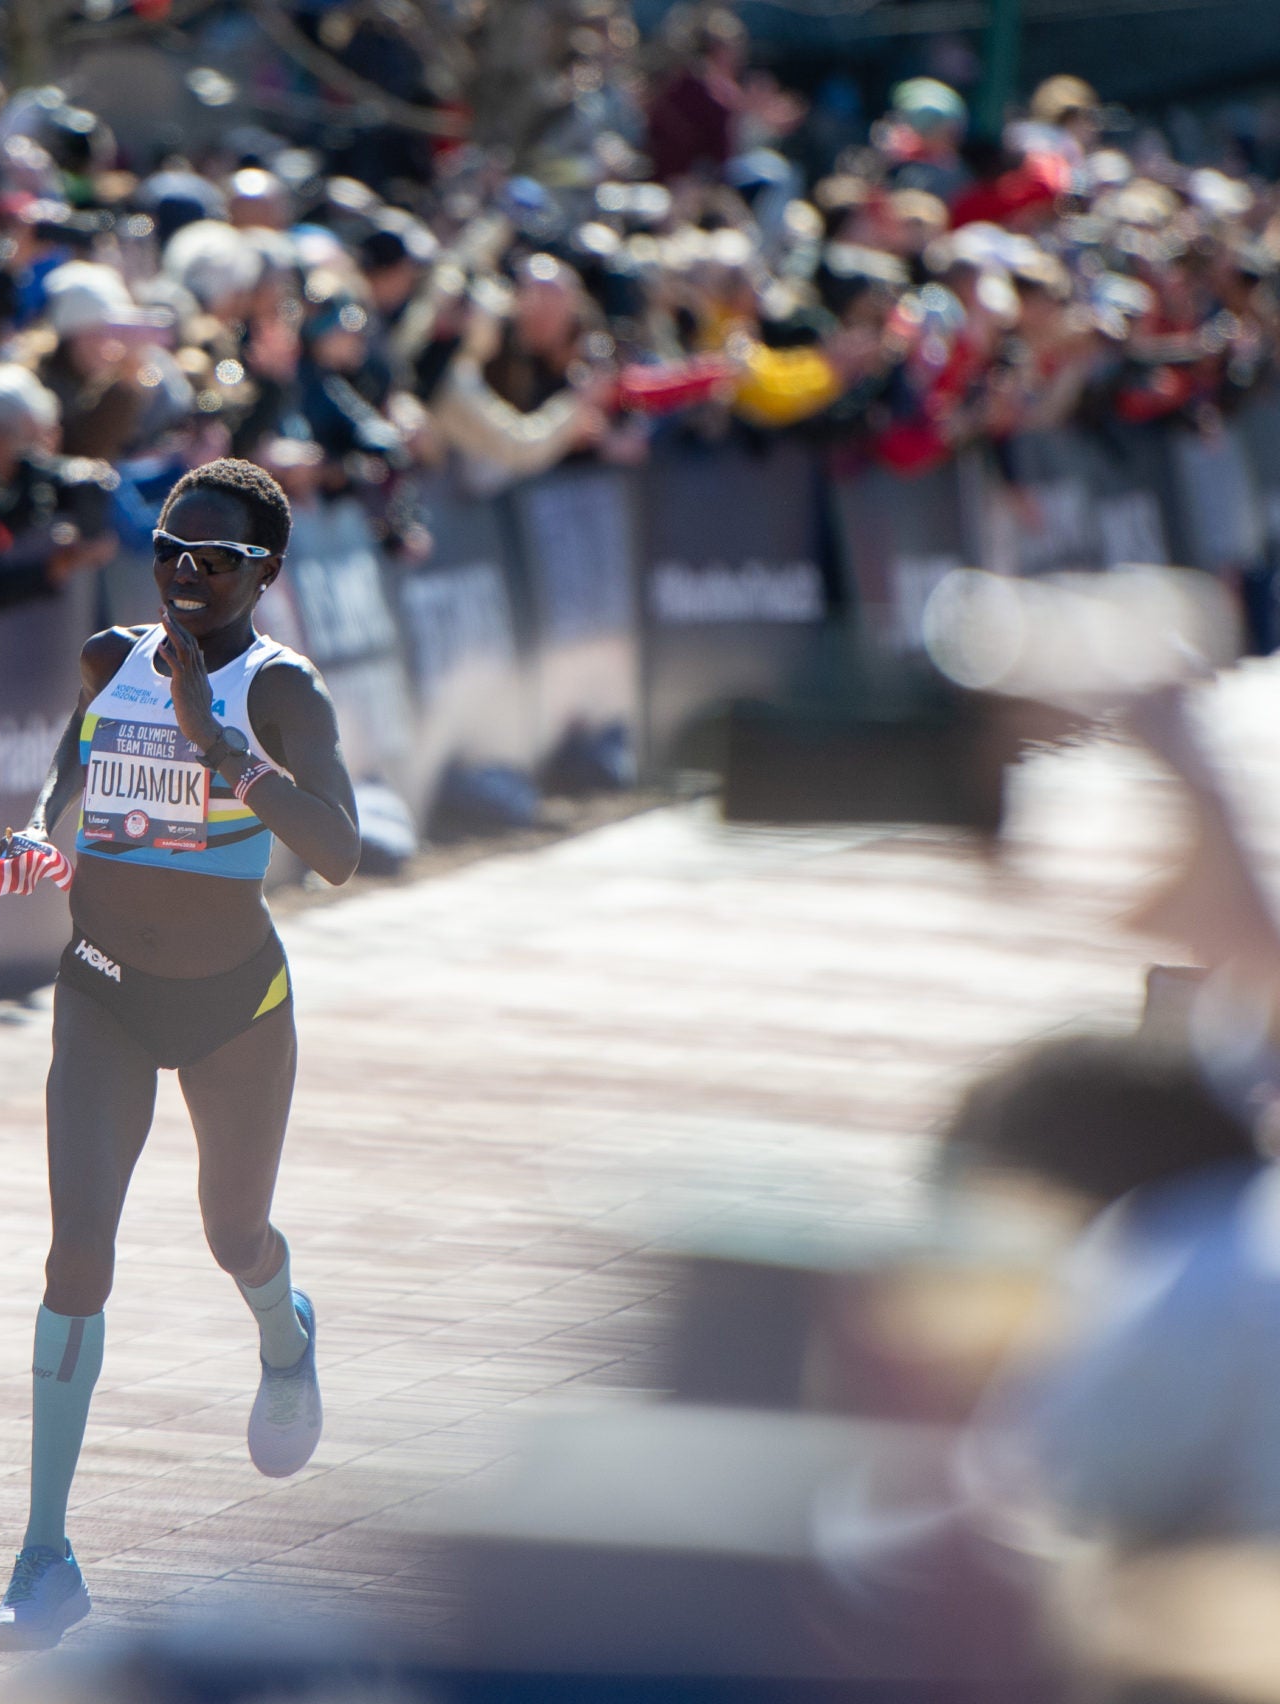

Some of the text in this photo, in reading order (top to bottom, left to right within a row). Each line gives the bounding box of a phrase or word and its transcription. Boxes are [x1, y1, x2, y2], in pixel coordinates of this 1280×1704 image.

[111, 689, 160, 705] ARIZONA ELITE
[117, 684, 152, 697] NORTHERN
[118, 724, 177, 744] U.S. OLYMPIC
[116, 738, 176, 759] TEAM TRIALS
[91, 759, 202, 806] TULIAMUK
[74, 938, 121, 982] HOKA
